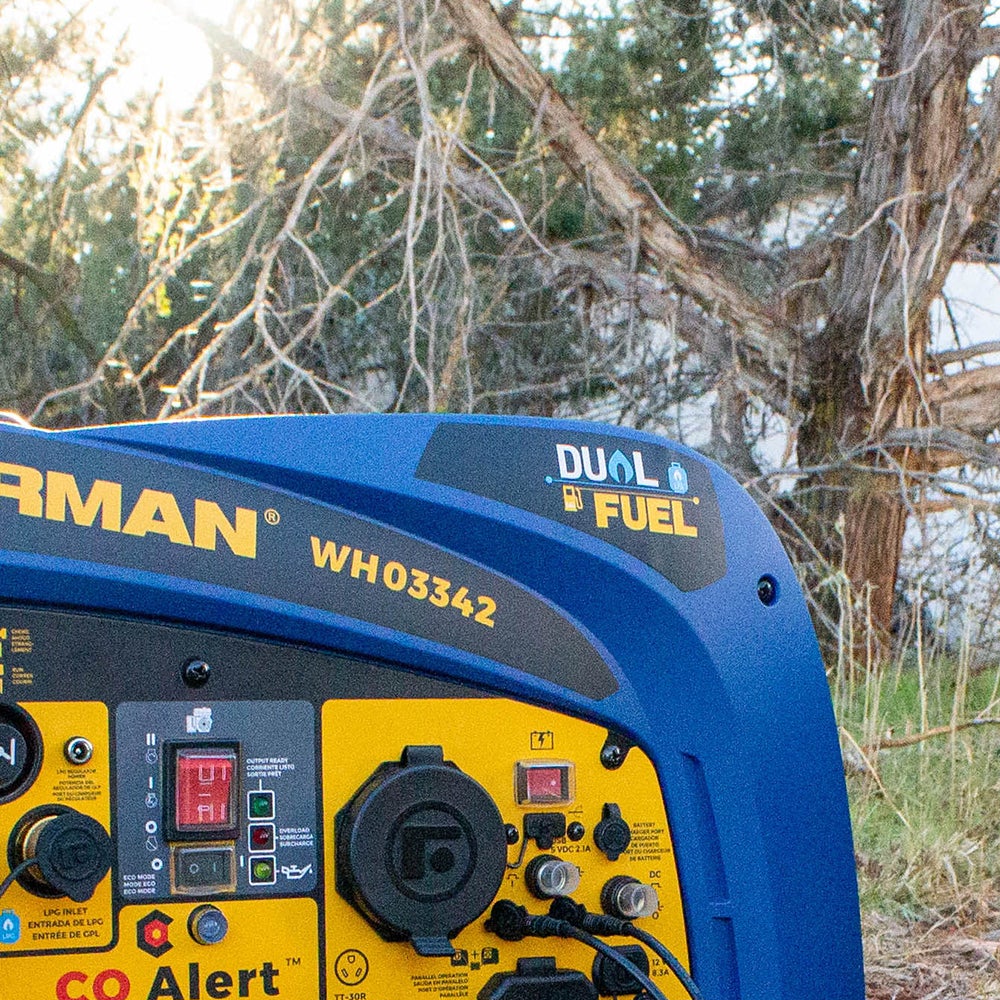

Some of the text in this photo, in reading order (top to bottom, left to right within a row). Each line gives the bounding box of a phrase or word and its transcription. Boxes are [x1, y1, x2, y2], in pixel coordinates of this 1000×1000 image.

[594, 491, 698, 537] FUEL
[310, 536, 497, 627] WH03342
[649, 870, 661, 878] DC
[43, 908, 88, 917] LPG INLET
[28, 919, 70, 929] ENTRADA
[32, 931, 67, 940] ENTRÉE
[69, 931, 81, 939] DE
